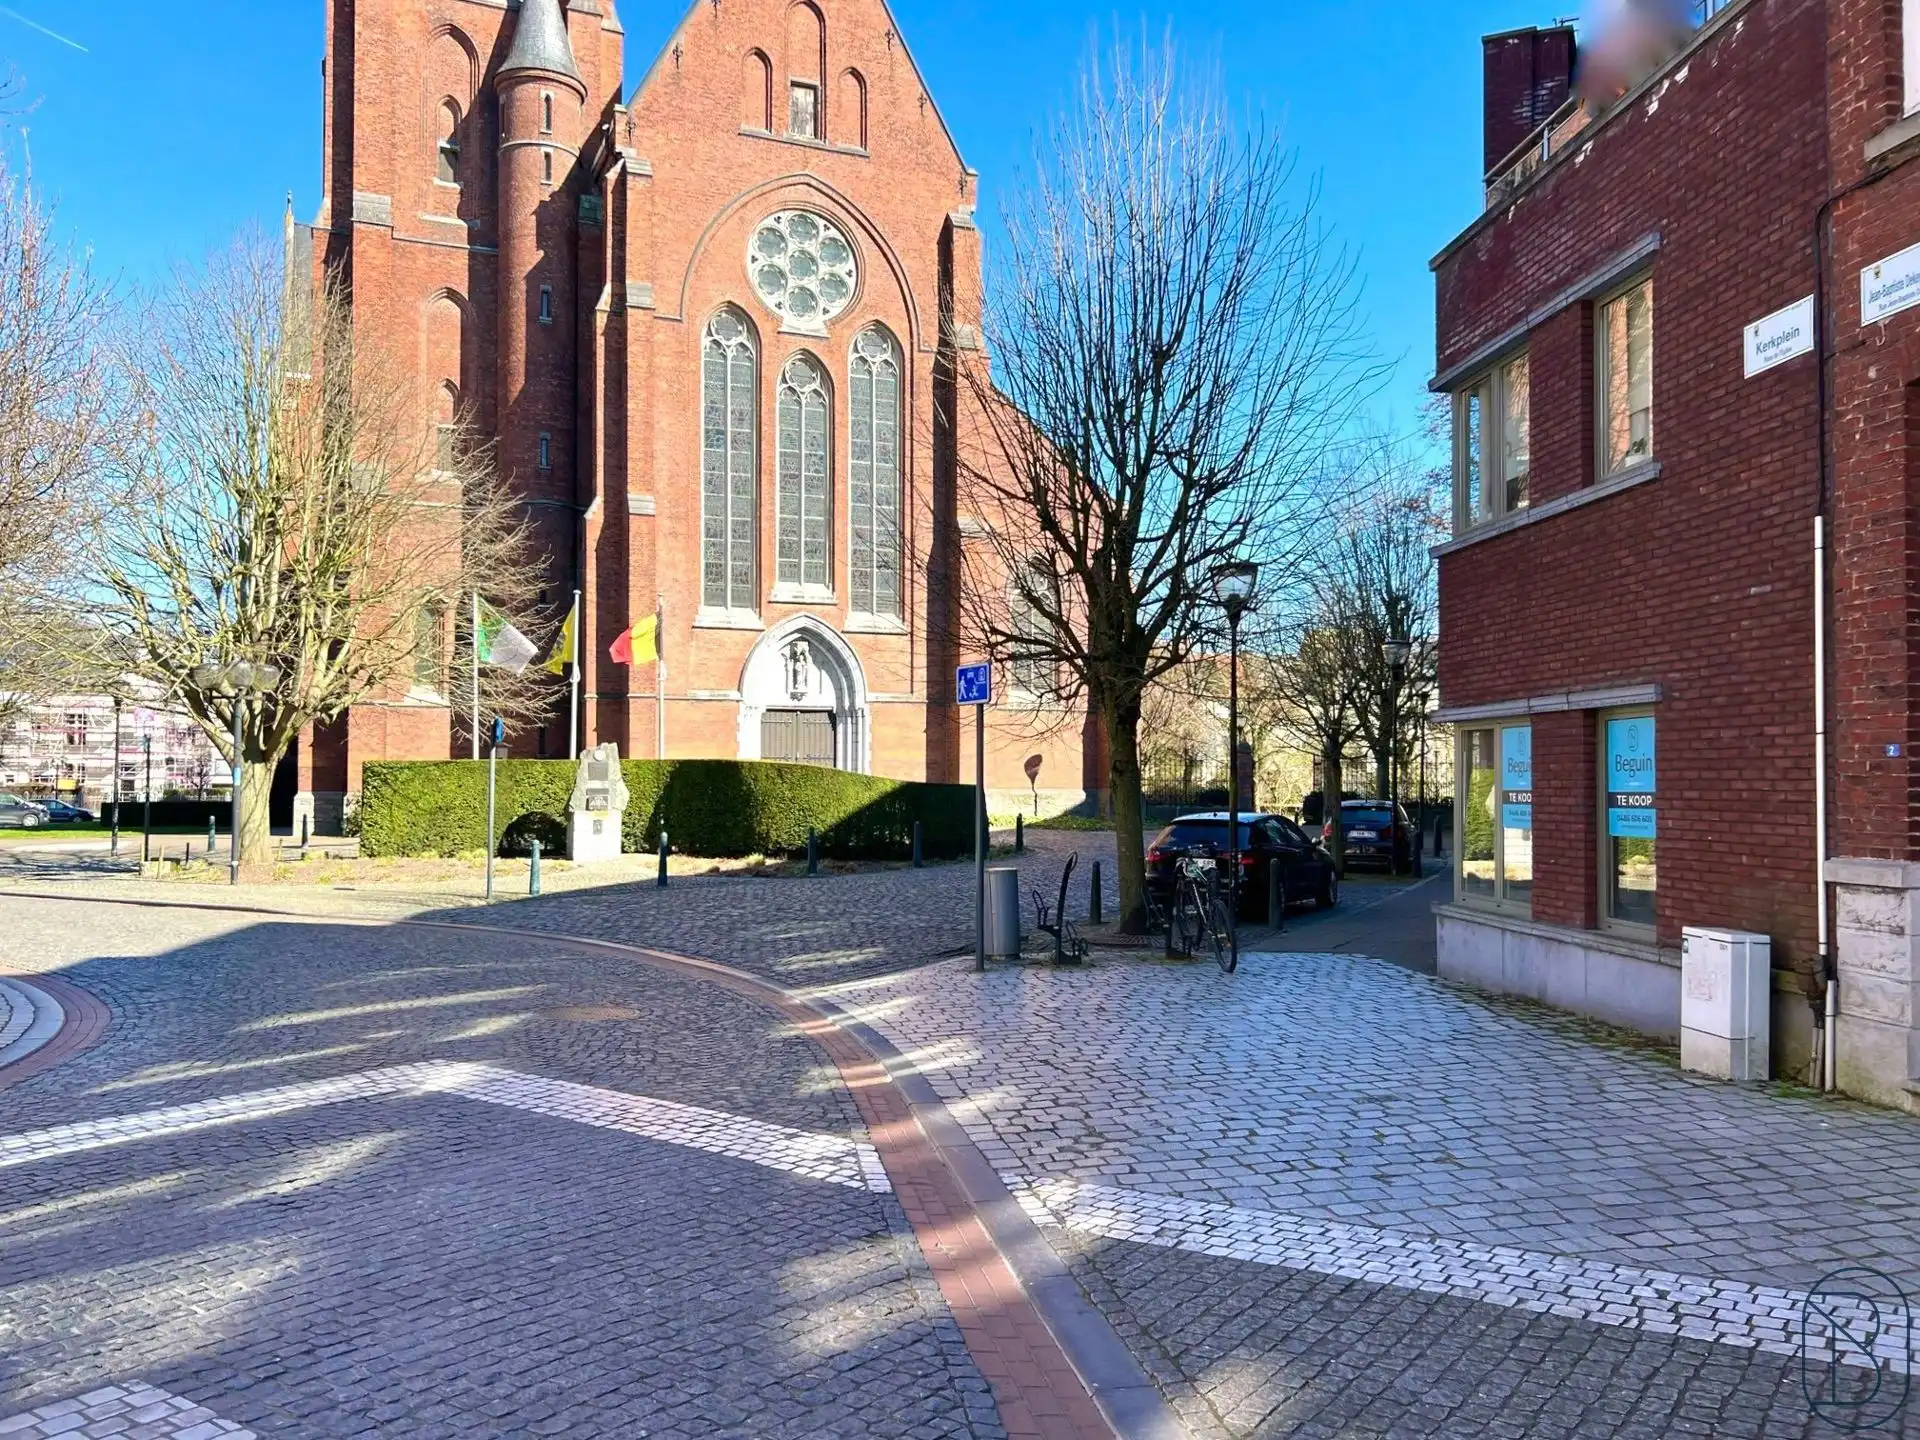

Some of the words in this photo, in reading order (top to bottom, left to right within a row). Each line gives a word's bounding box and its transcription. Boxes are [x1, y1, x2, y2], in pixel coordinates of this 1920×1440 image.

[1756, 326, 1800, 356] Kerkplein
[1615, 753, 1653, 778] Beguin
[1509, 792, 1517, 803] TE
[1518, 792, 1532, 803] KOO
[1616, 795, 1627, 806] TE
[1628, 795, 1653, 806] KOOP
